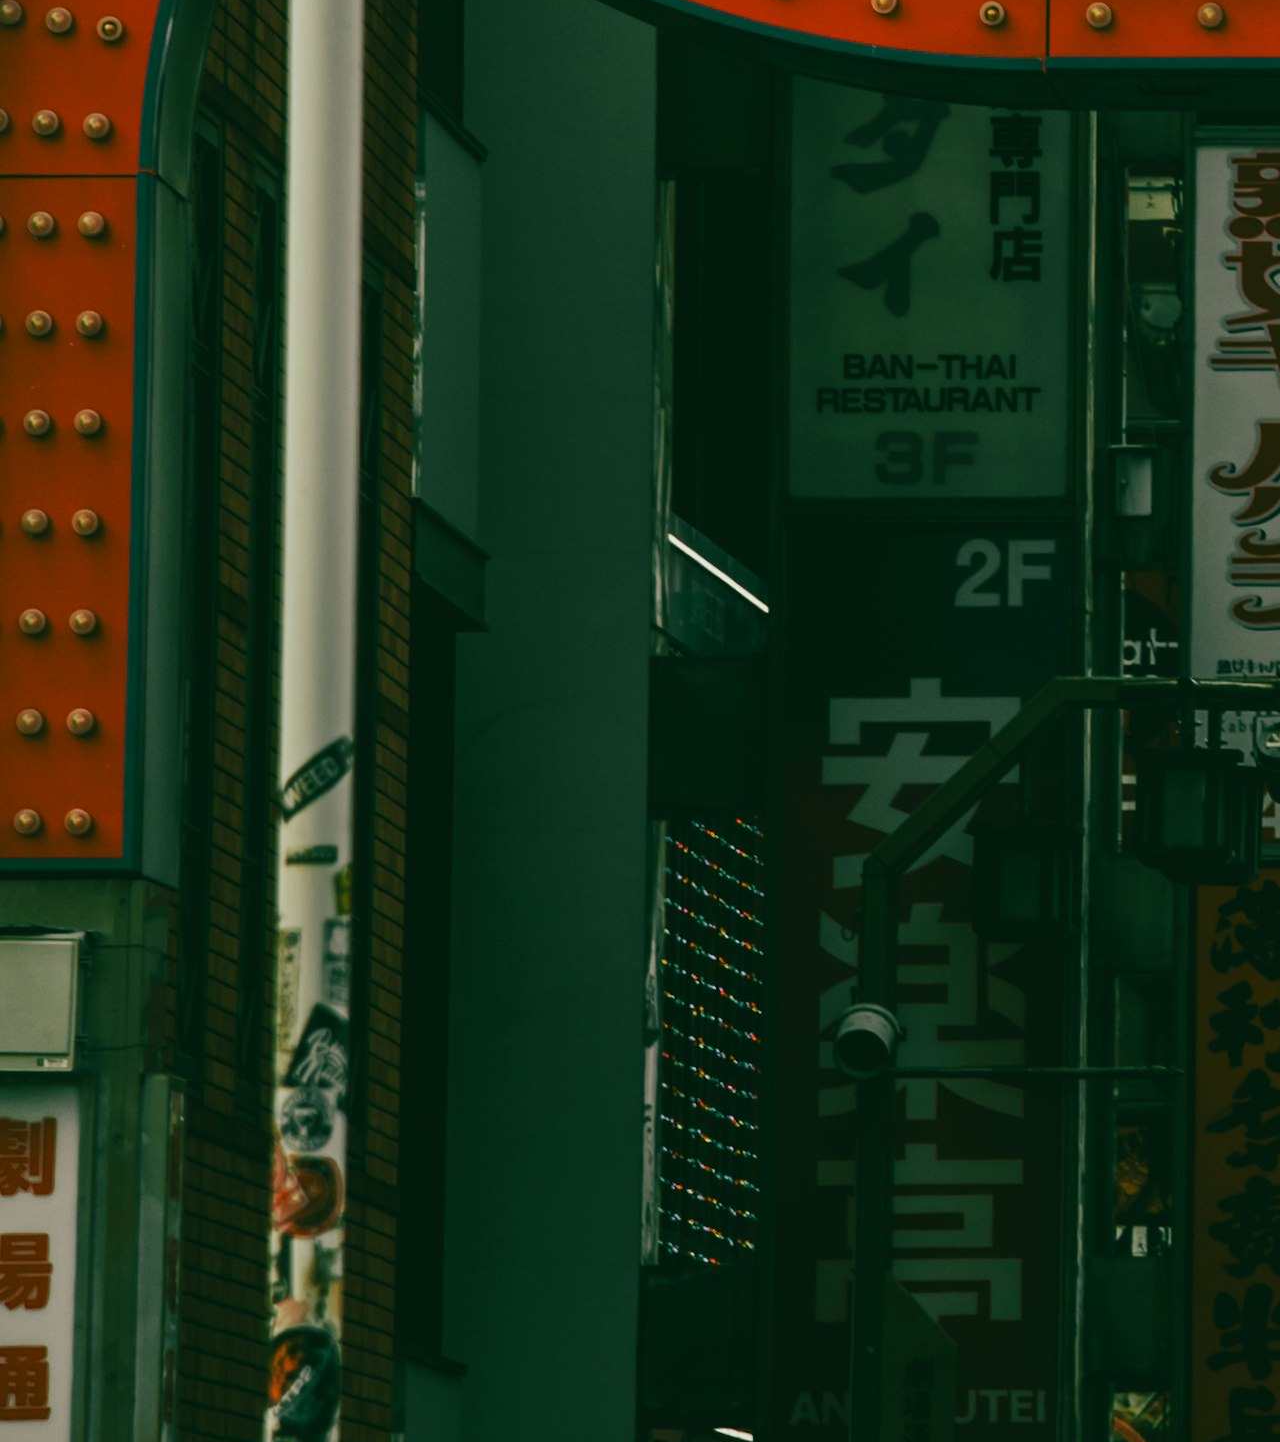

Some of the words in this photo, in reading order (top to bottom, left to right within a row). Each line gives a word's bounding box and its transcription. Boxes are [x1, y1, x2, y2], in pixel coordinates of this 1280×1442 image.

[844, 354, 1016, 380] BAN-THAI
[817, 388, 1040, 414] RESTAURANT
[873, 431, 978, 485] 3F
[954, 539, 1056, 608] 2F
